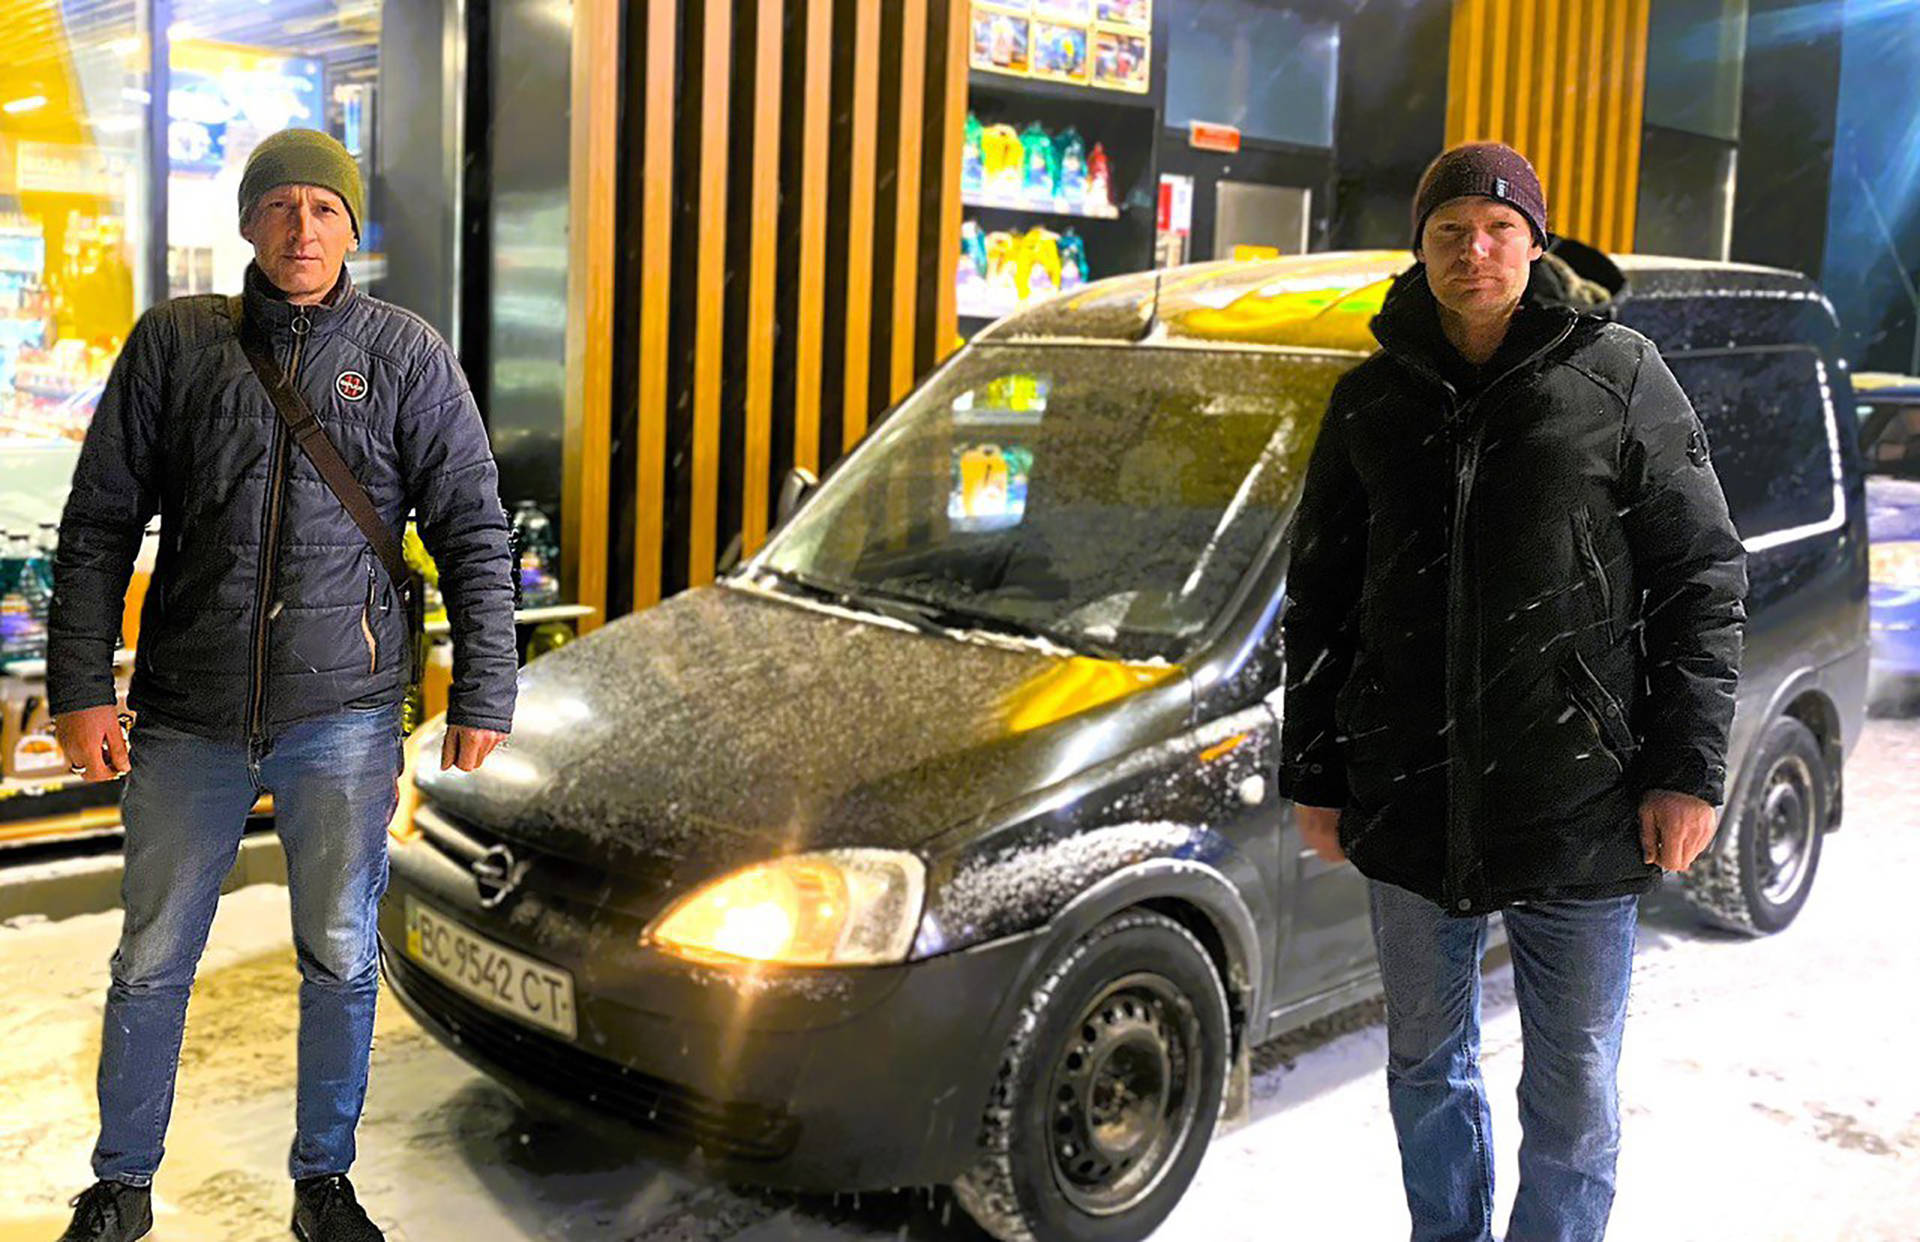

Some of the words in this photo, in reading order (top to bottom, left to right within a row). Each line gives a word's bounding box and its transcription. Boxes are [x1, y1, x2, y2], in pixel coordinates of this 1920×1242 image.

[420, 913, 450, 967] BC
[455, 937, 514, 1002] 9542
[521, 969, 563, 1021] CT
